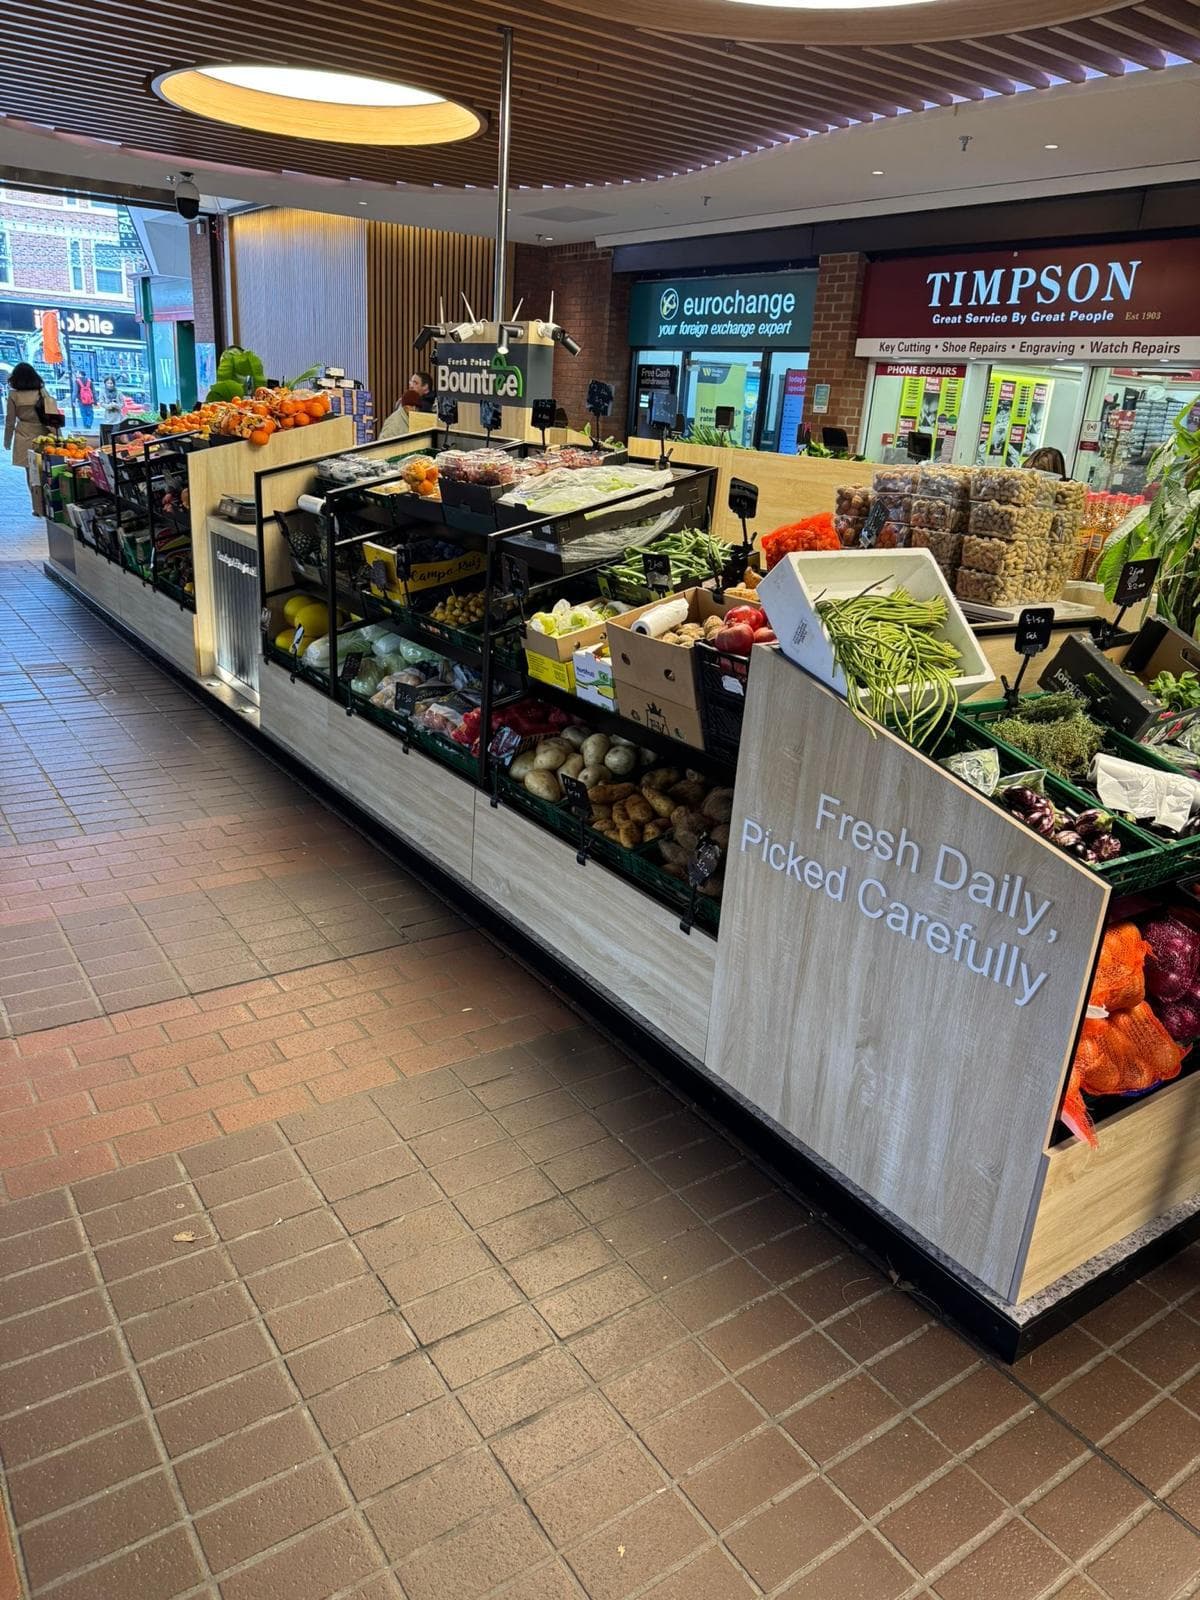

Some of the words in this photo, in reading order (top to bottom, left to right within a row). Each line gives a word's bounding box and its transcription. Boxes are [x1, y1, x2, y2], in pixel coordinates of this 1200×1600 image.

[926, 260, 1142, 307] TIMPSON
[683, 289, 795, 319] eurochange
[932, 313, 962, 324] Great
[965, 312, 1008, 324] Service
[1011, 311, 1027, 325] By
[1031, 311, 1065, 323] Great
[1069, 310, 1114, 324] People
[1125, 311, 1140, 321] Est
[1142, 311, 1162, 321] 1903
[658, 324, 678, 338] your
[679, 321, 709, 338] foreign
[710, 320, 755, 338] exchange
[758, 320, 792, 337] expert
[879, 341, 896, 354] Key
[897, 341, 931, 355] Cutting
[942, 341, 967, 353] Shoe
[969, 341, 1007, 354] Repairs
[1019, 341, 1075, 355] Engraving
[1089, 341, 1128, 354] Watch
[1132, 341, 1181, 355] Repairs
[448, 357, 467, 366] Fresh
[470, 358, 491, 367] Point
[655, 368, 671, 378] Cash
[887, 365, 918, 375] PHONE
[919, 366, 957, 376] REPAIRS
[437, 365, 520, 397] Bountree
[815, 793, 922, 874] Fresh
[933, 844, 1058, 945] Daily,
[739, 817, 849, 903] Picked
[858, 877, 1050, 1008] Carefully
